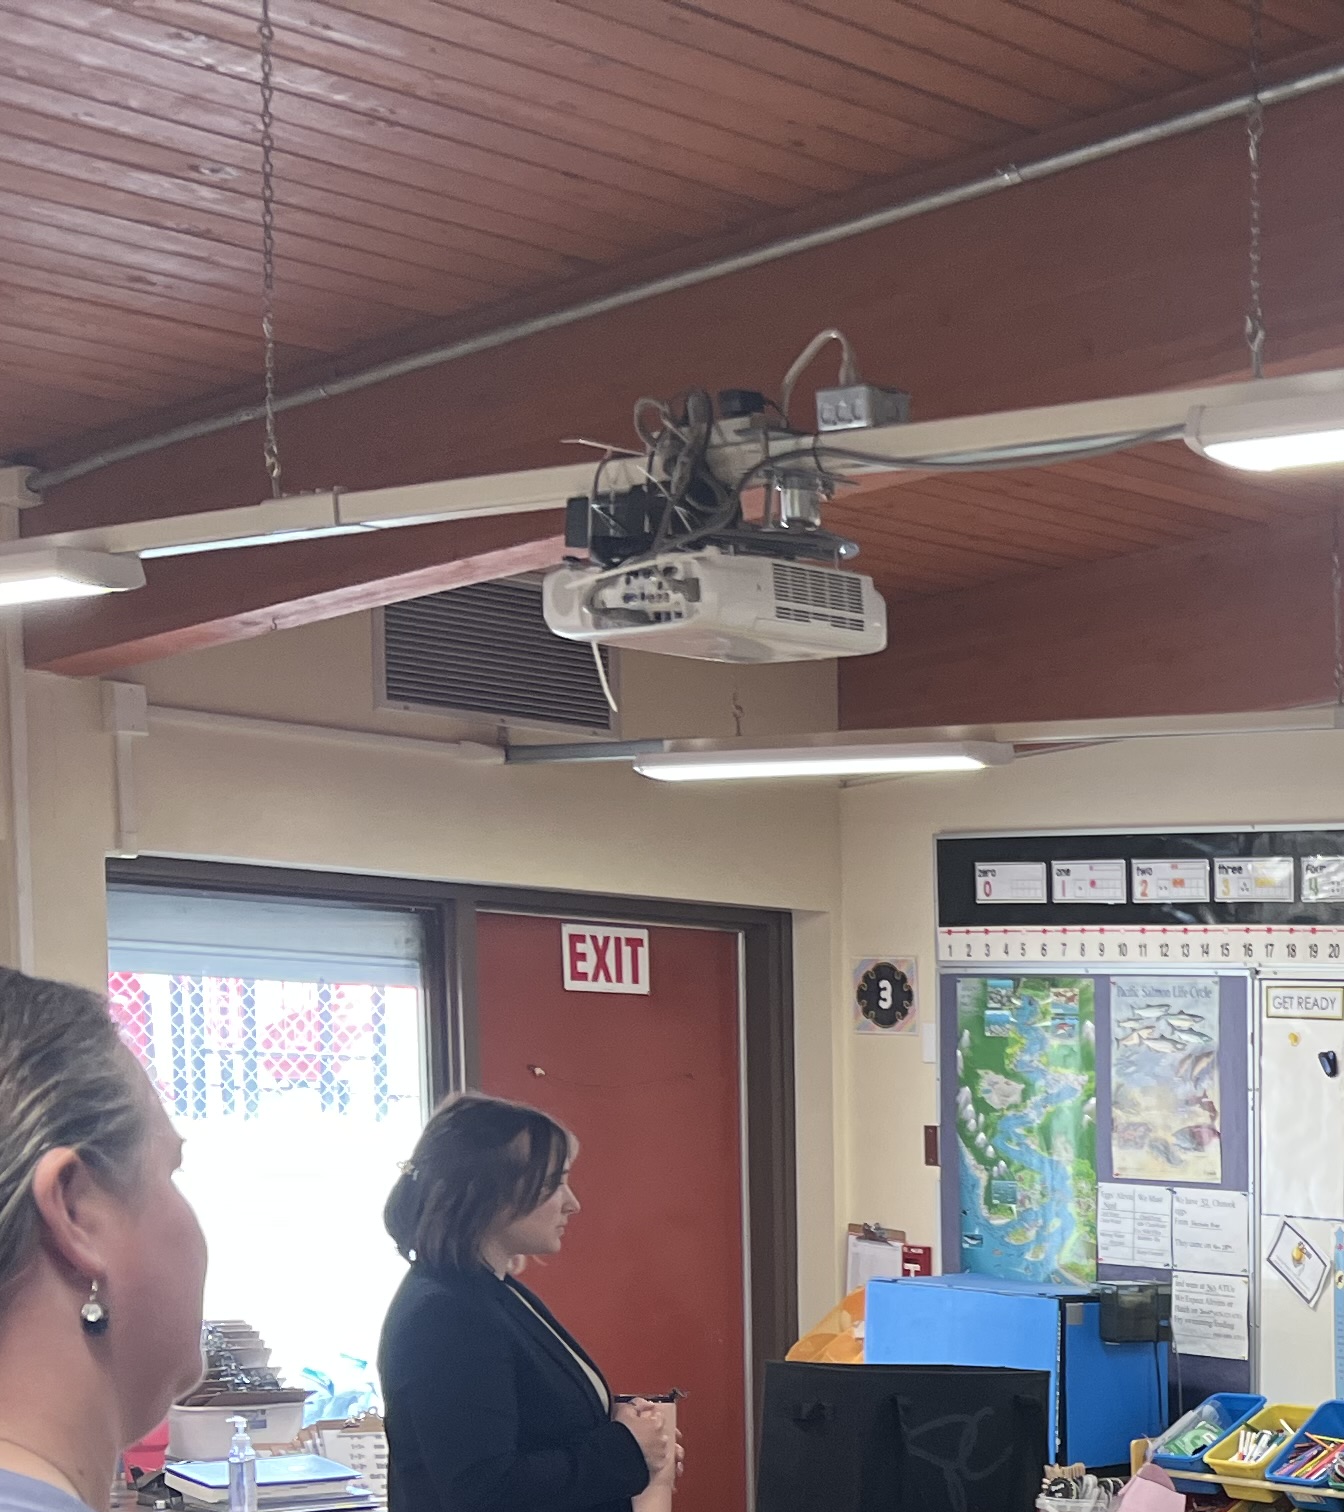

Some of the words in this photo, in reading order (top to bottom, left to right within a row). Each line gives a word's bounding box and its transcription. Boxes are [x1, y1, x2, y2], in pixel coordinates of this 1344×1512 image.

[567, 932, 645, 985] EXIT
[877, 979, 893, 1010] 3
[1272, 996, 1296, 1011] GET
[1298, 996, 1336, 1013] READY
